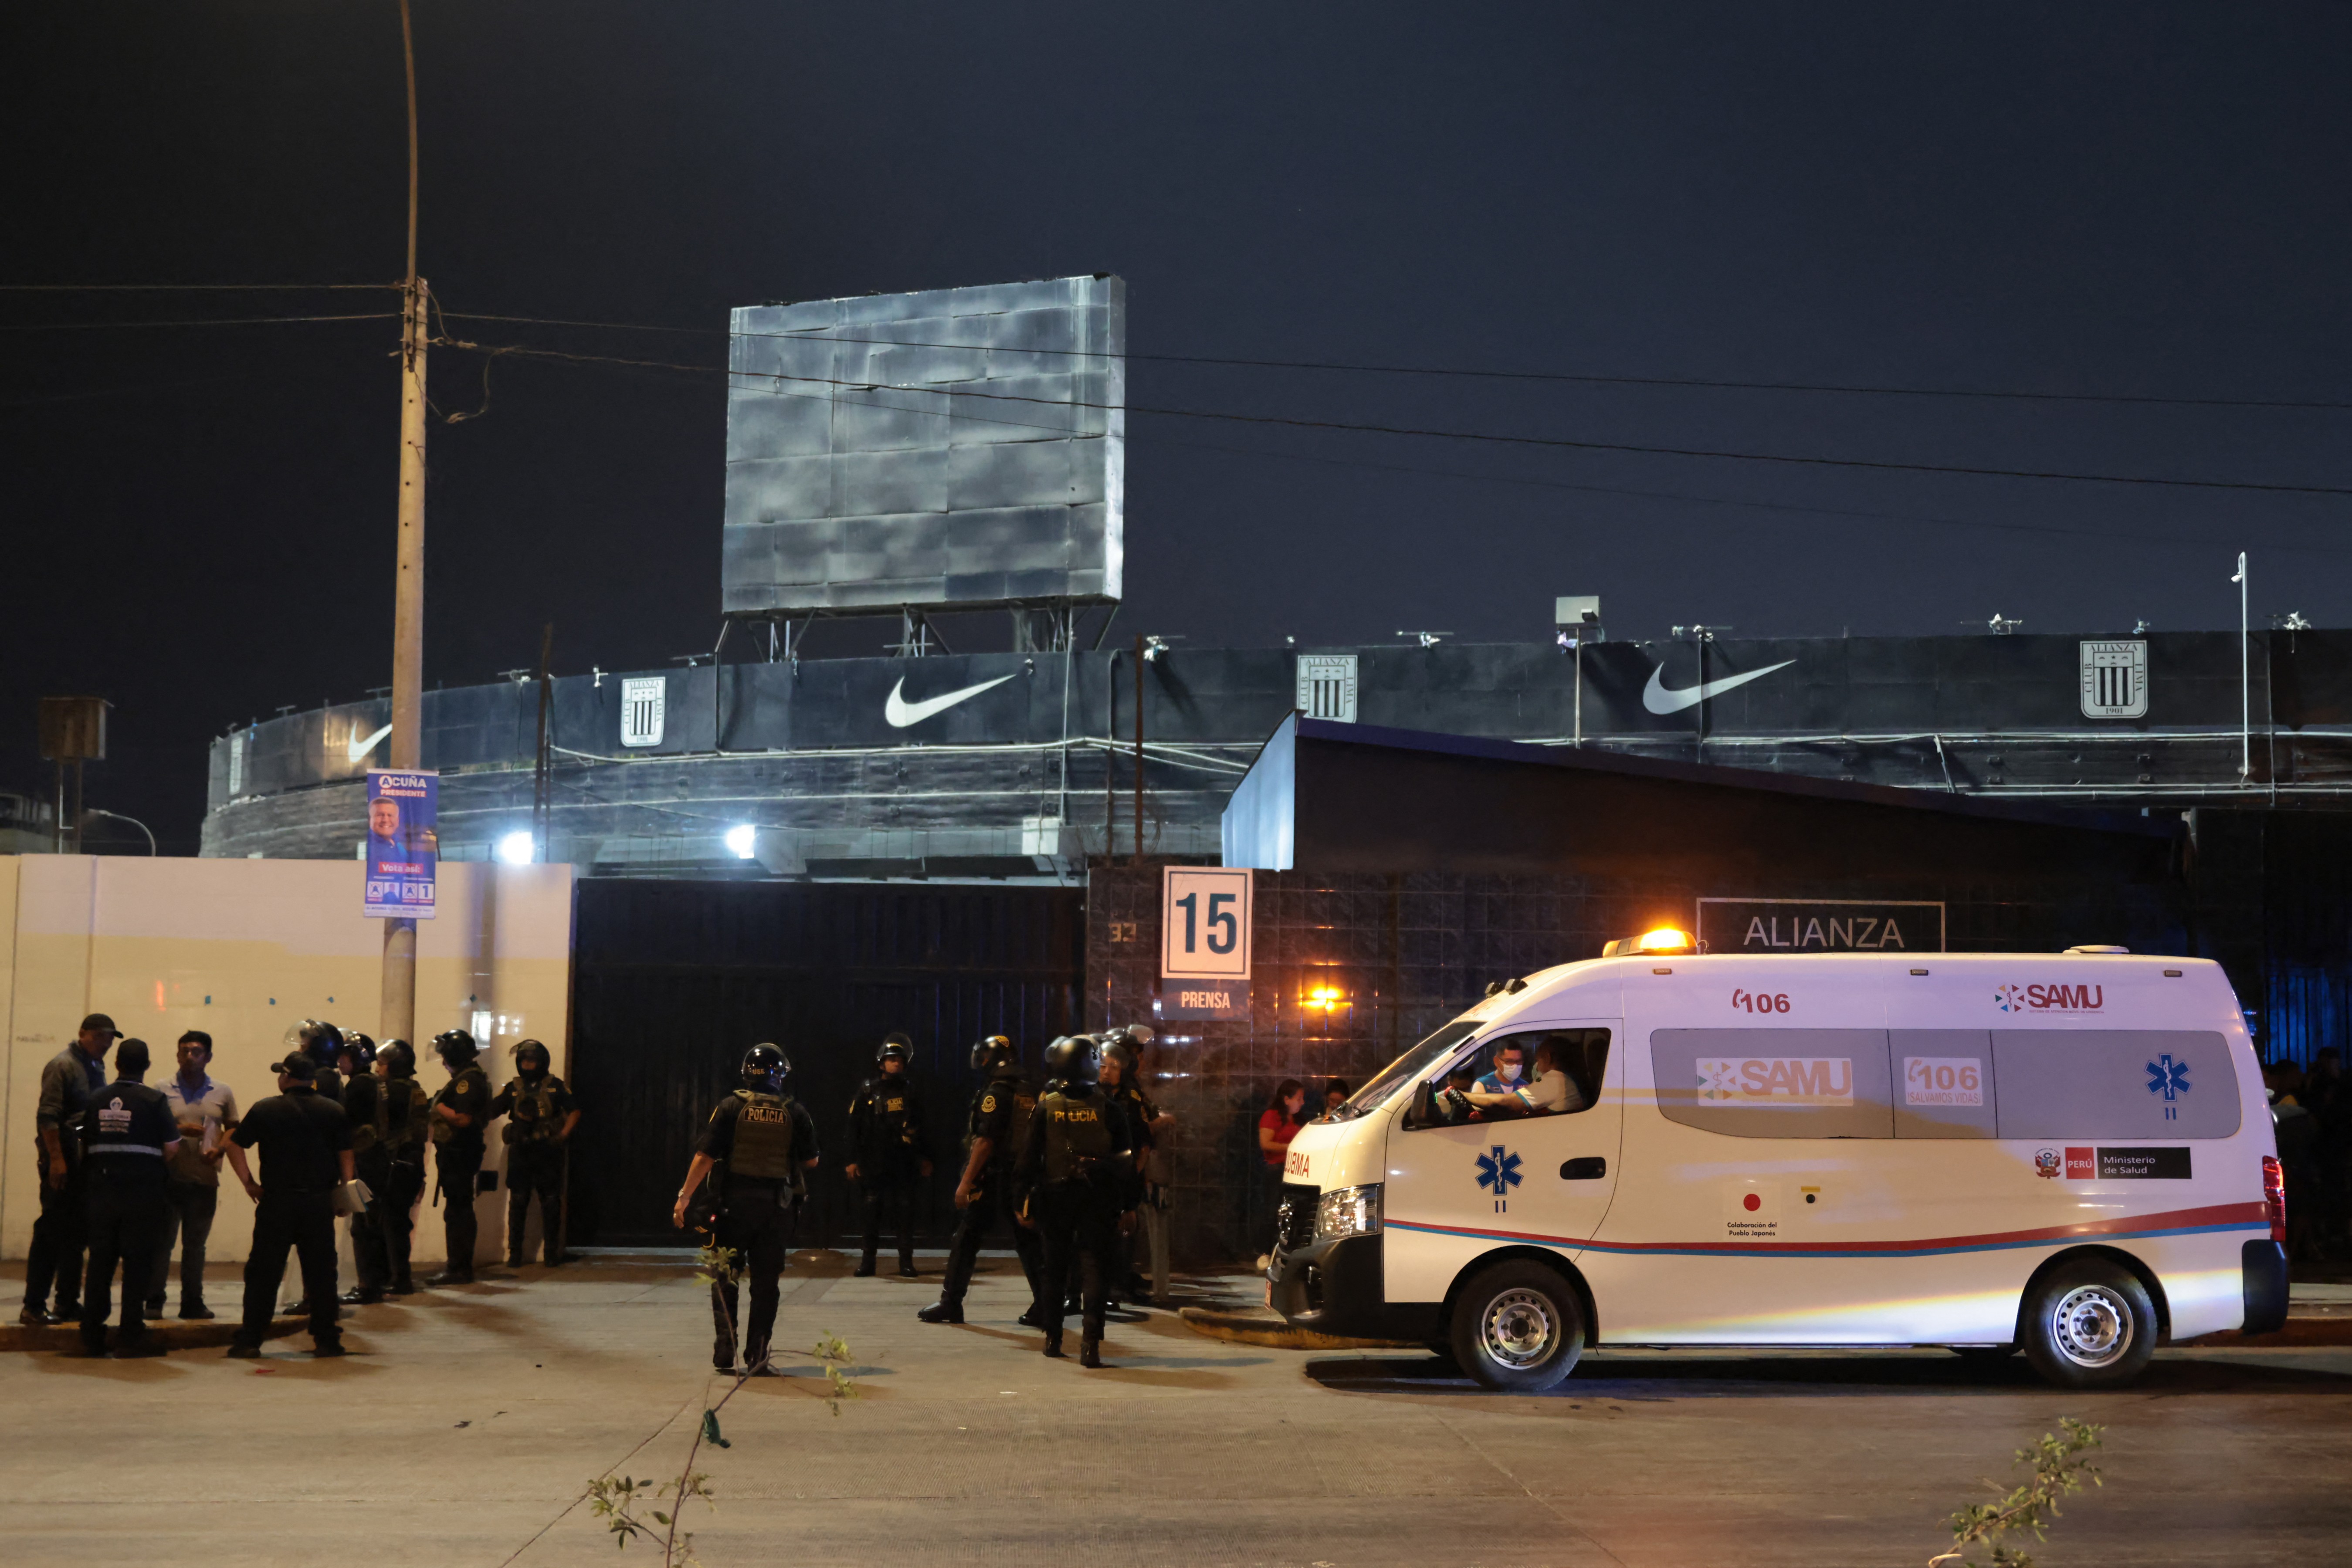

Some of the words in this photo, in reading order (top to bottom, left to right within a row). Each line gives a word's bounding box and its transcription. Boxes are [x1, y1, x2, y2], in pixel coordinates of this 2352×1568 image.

[381, 776, 427, 788] ACUÑA
[423, 885, 428, 897] 1
[1176, 893, 1237, 955] 15
[1743, 917, 1905, 948] ALIANZA
[1181, 992, 1230, 1008] PRENSA
[1740, 994, 1790, 1013] 106
[2027, 985, 2103, 1008] SAMU
[1741, 1060, 1851, 1096] SAMU
[1918, 1065, 1979, 1090] 106
[748, 1108, 784, 1123] POLICIA
[2068, 1158, 2092, 1168] PERÚ
